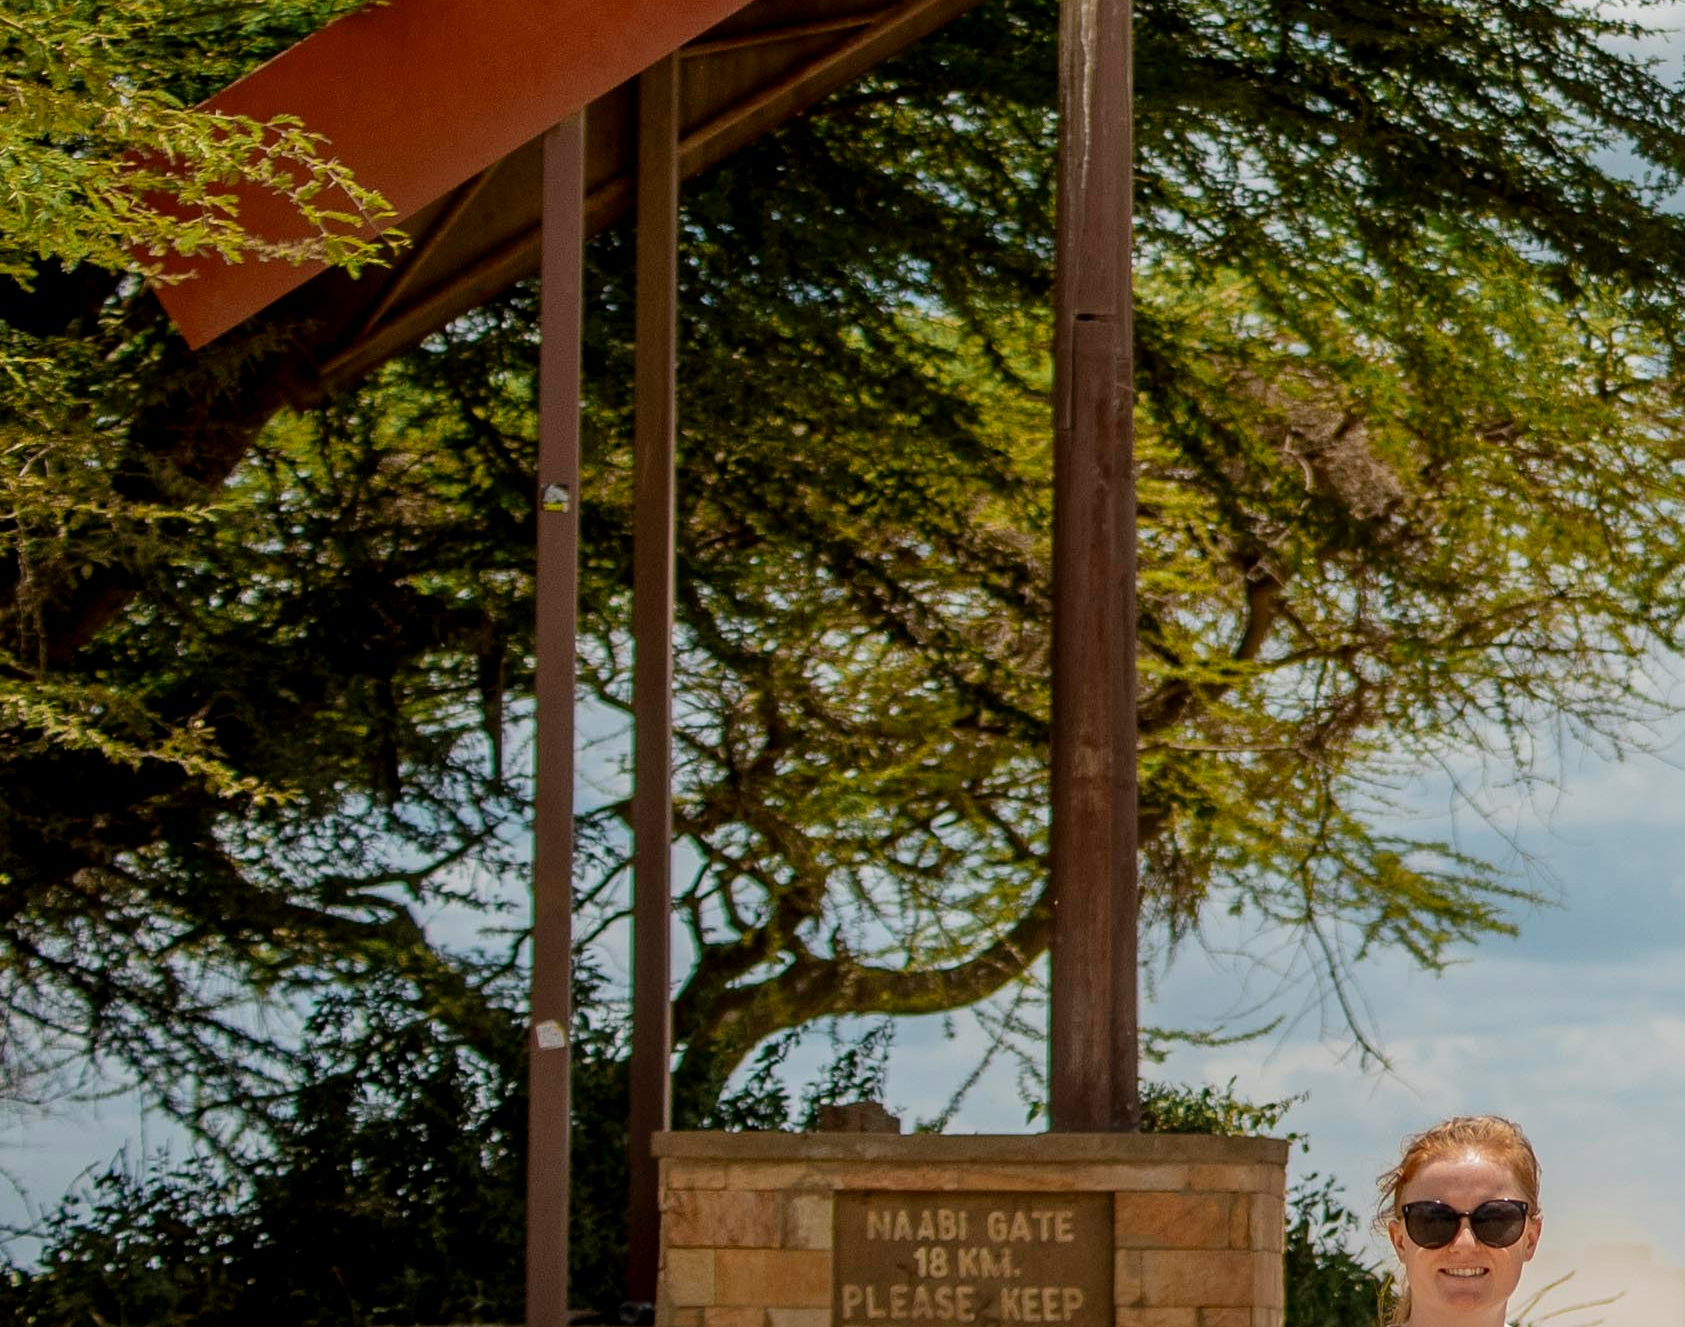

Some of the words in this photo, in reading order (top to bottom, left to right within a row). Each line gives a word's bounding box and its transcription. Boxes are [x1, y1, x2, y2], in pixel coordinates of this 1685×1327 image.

[865, 1208, 969, 1241] NAABI
[987, 1210, 1075, 1243] GATE
[913, 1246, 949, 1278] 18
[841, 1284, 976, 1322] PLEASE
[1001, 1286, 1084, 1322] KEEP
